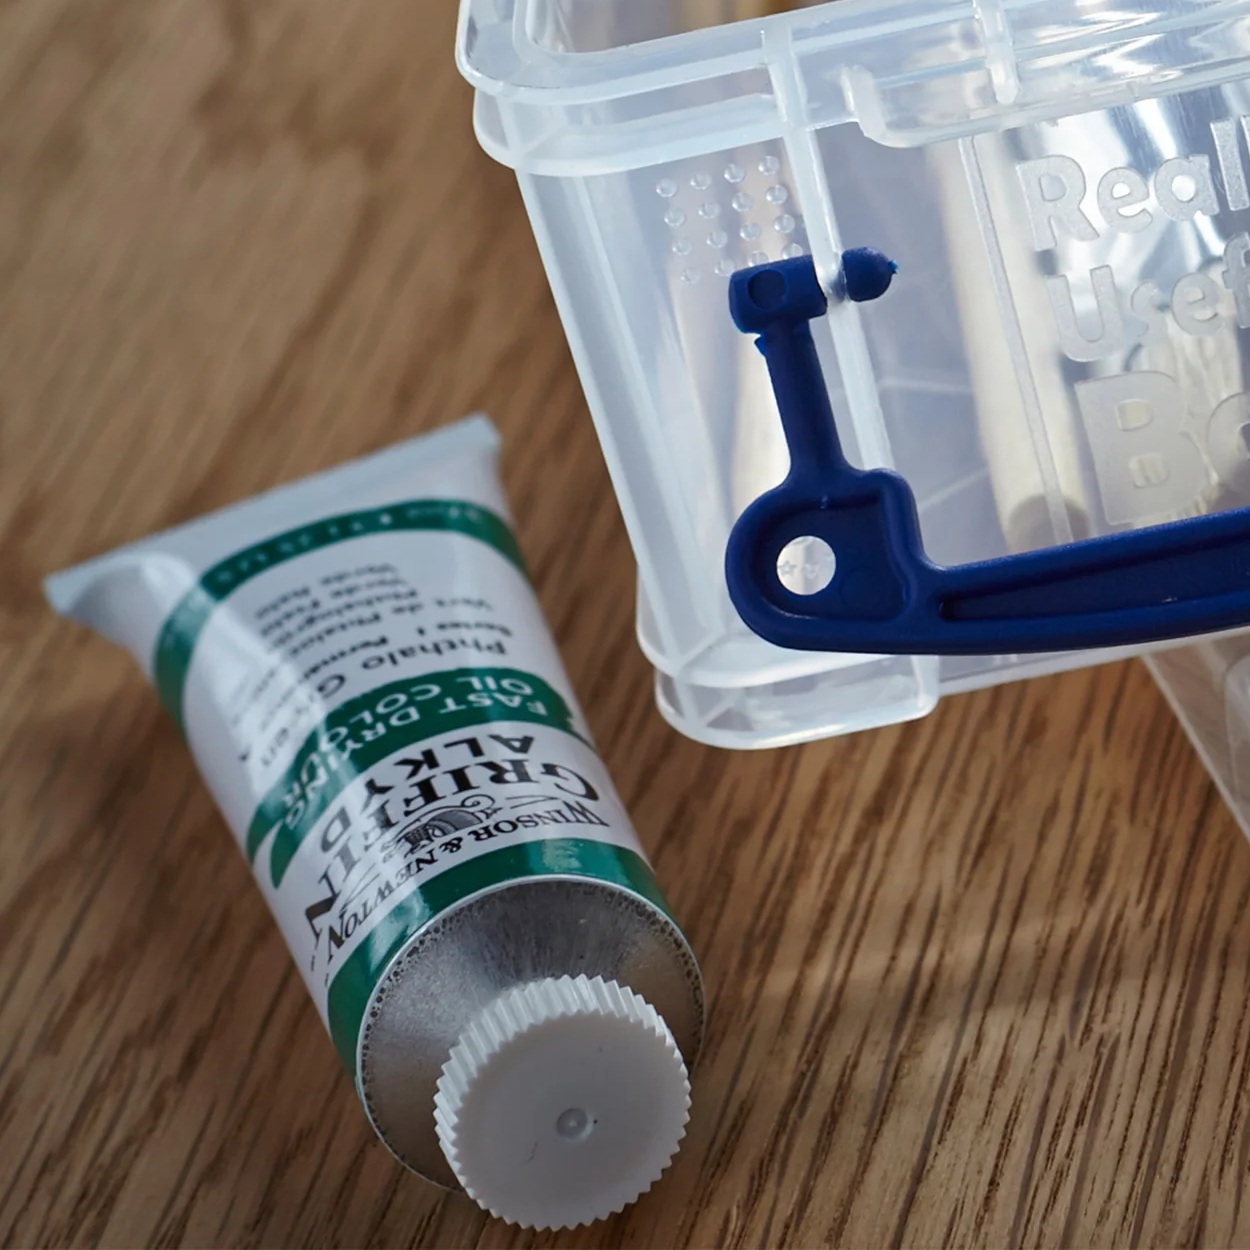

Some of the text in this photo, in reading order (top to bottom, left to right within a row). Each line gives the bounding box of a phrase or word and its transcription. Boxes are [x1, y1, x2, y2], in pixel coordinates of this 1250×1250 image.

[361, 638, 507, 669] Phthalo
[283, 676, 534, 808] OIL COLOUR
[285, 692, 548, 830] FAST DRYING
[321, 734, 534, 854] ALKYD
[304, 758, 599, 950] GRIFFIN
[327, 800, 610, 965] WINSOR & NEWTON
